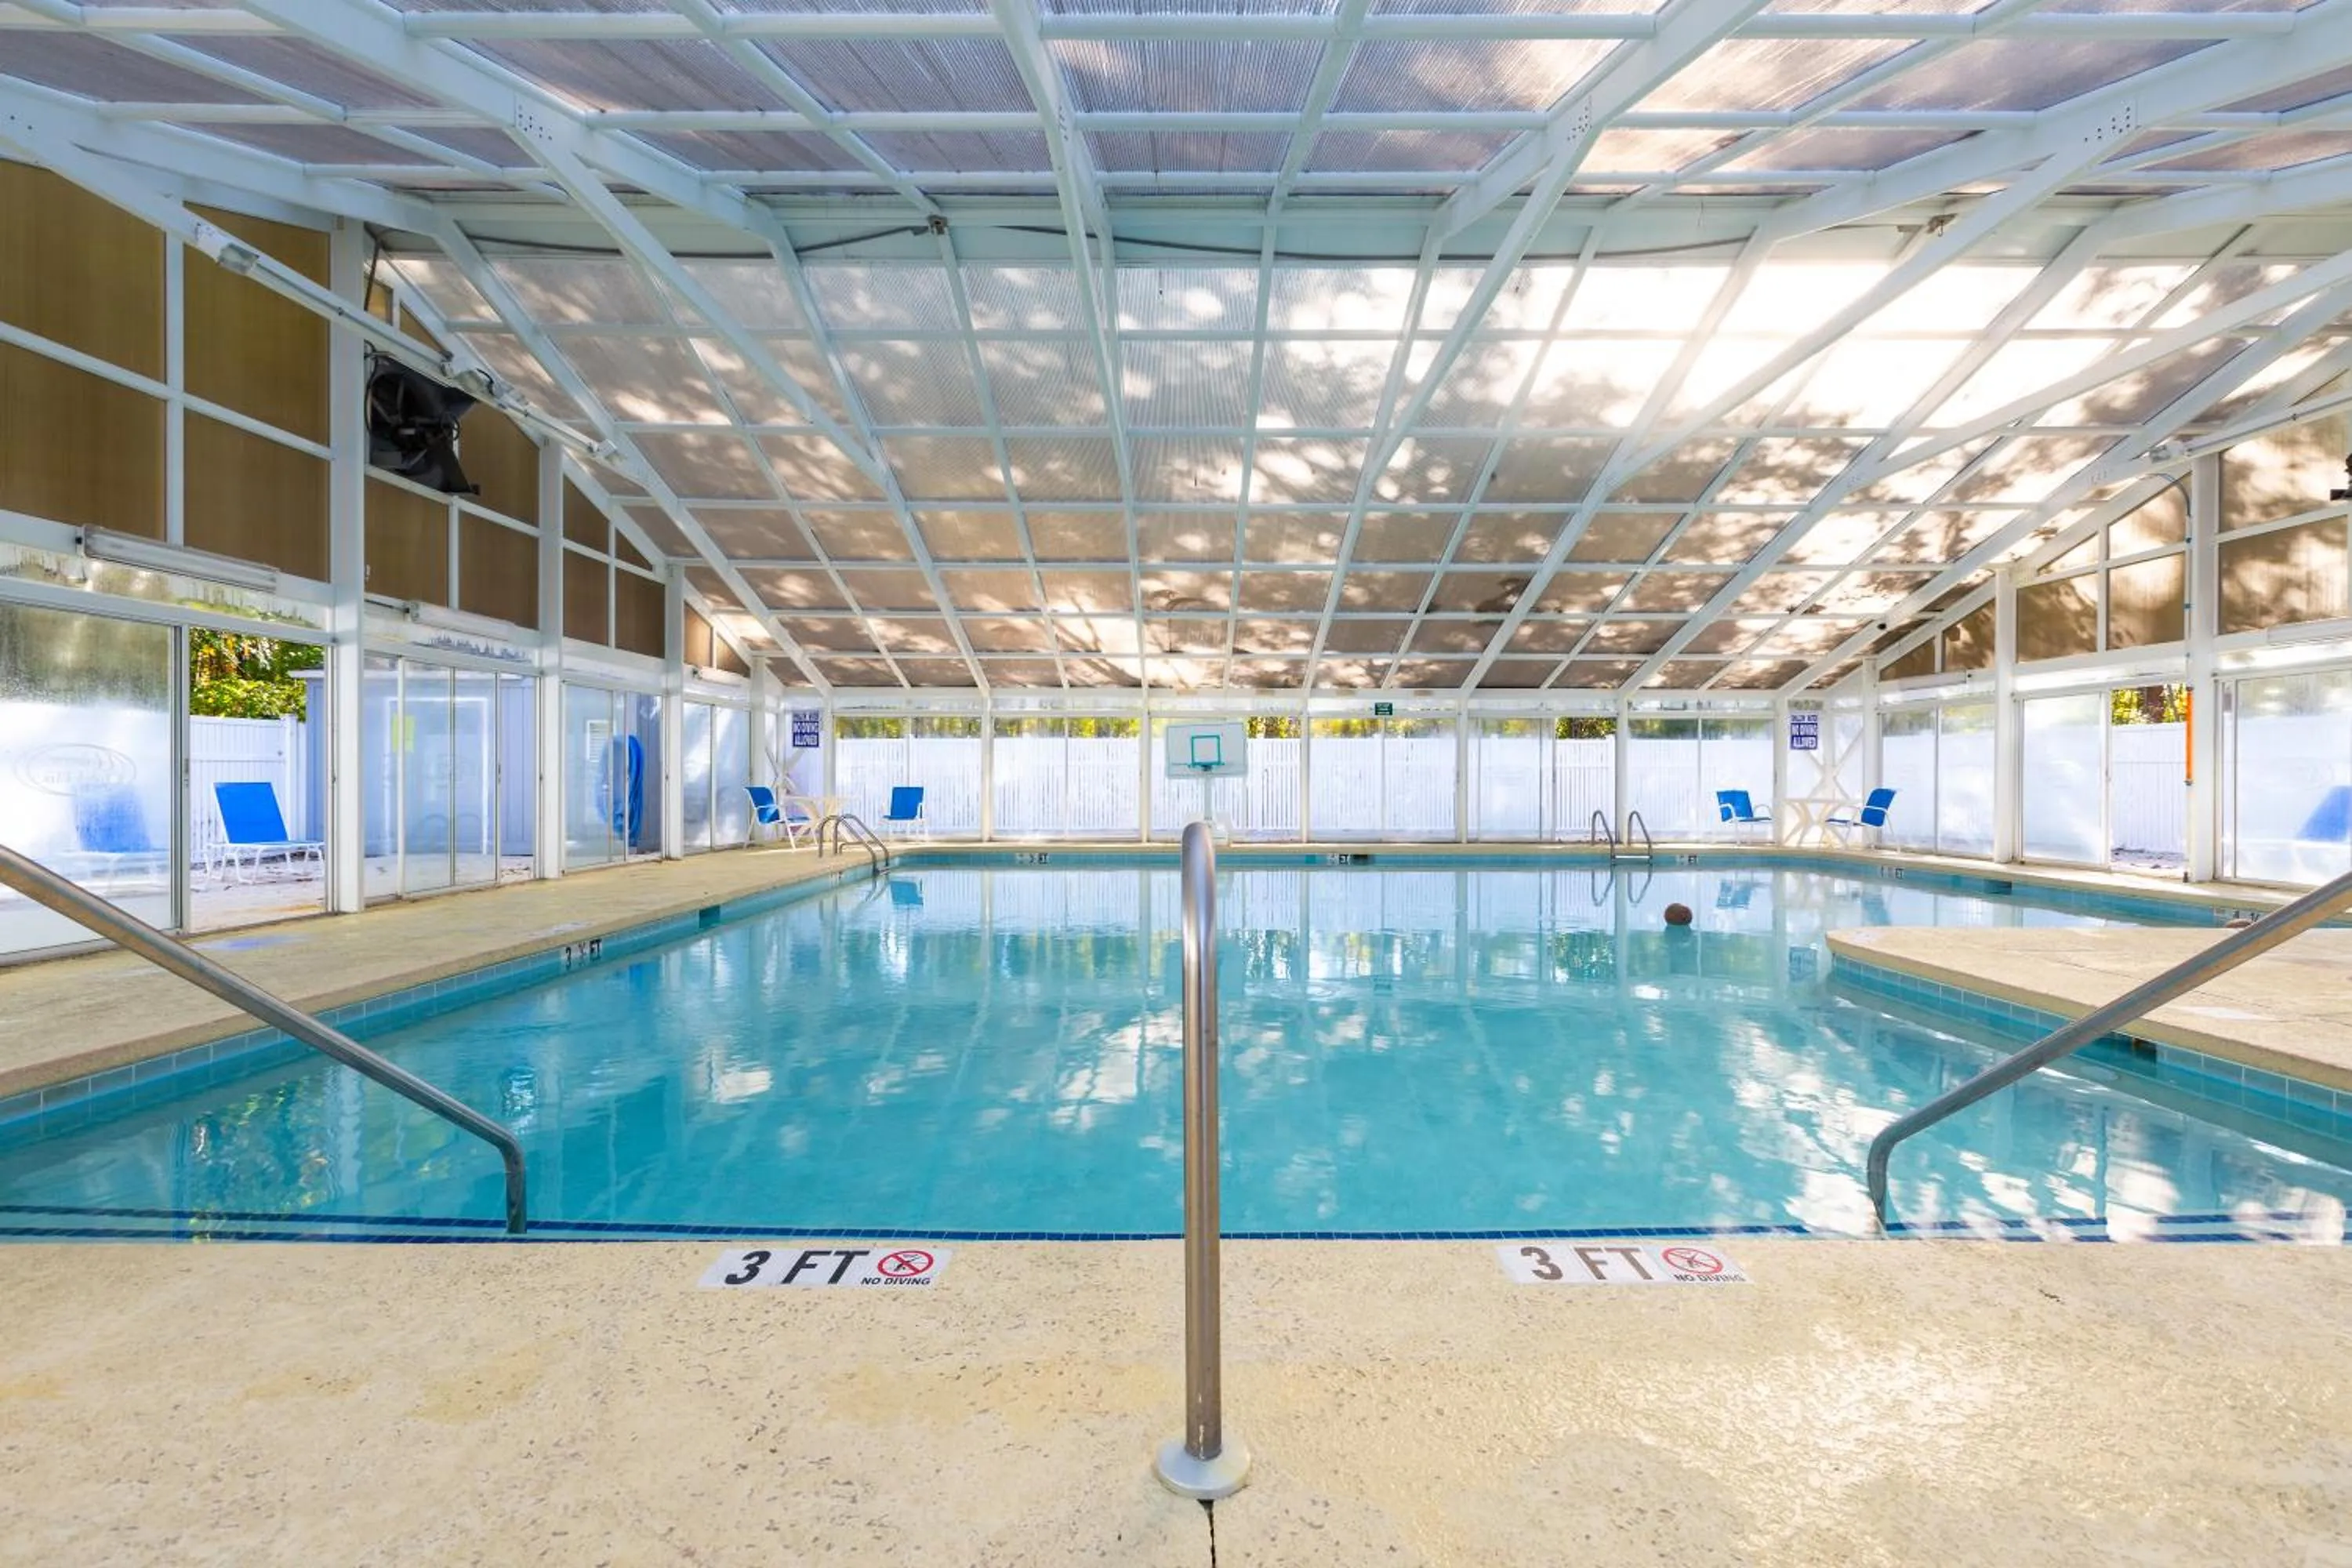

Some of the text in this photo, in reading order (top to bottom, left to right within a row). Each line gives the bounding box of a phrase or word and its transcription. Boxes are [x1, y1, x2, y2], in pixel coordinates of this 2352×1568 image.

[724, 1250, 870, 1285] 3 FT
[1520, 1246, 1653, 1281] 3 FT
